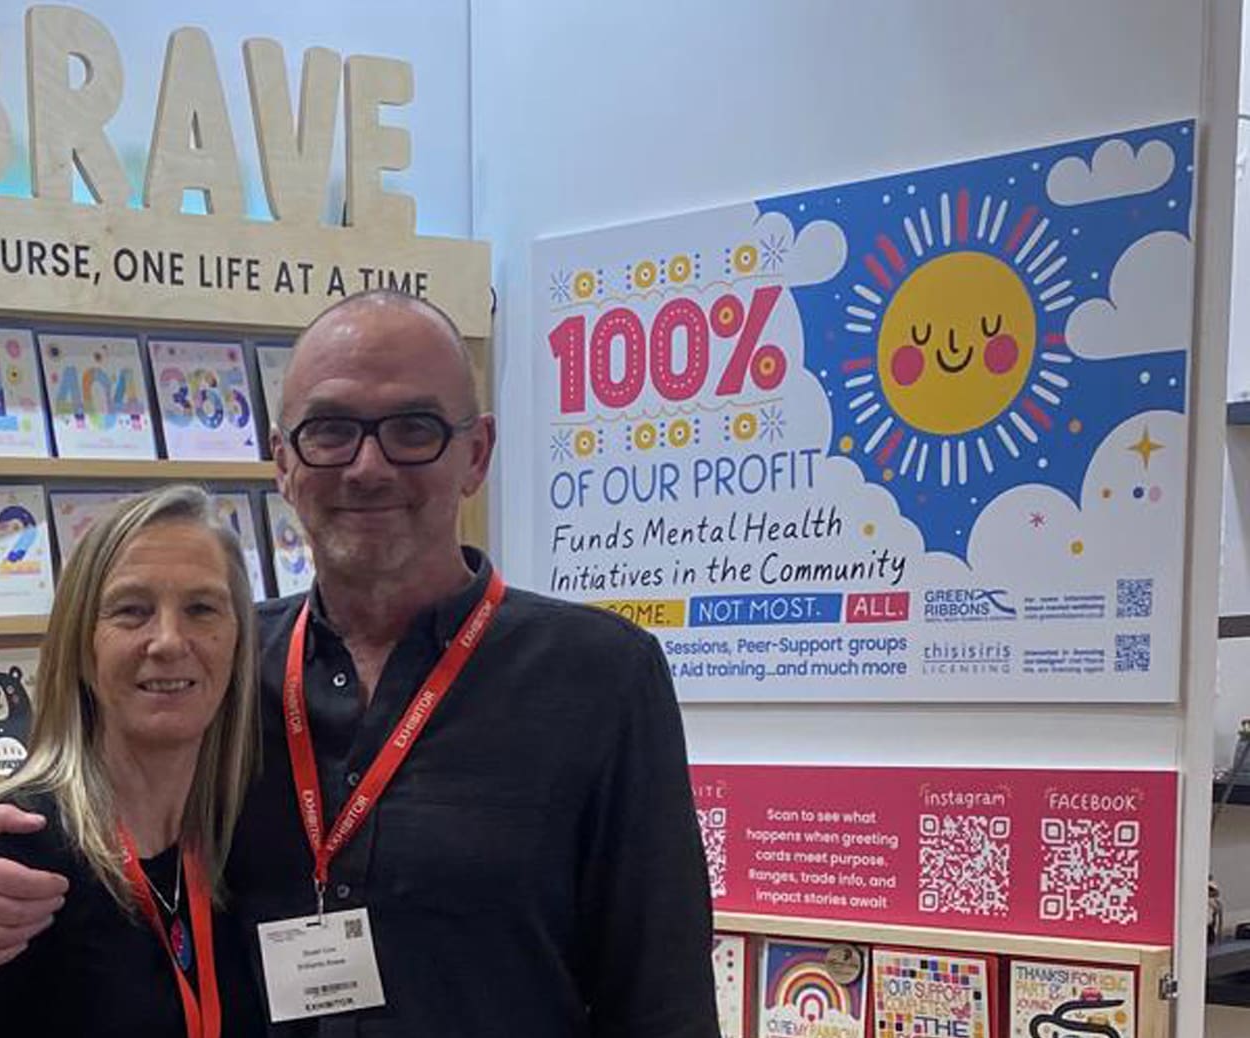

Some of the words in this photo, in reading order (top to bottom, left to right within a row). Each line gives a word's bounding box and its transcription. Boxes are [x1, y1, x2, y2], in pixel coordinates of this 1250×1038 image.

[113, 248, 185, 287] ONE
[199, 255, 260, 291] LIFE
[274, 261, 315, 294] AT
[327, 266, 346, 297] A
[358, 268, 428, 302] TIME
[548, 285, 787, 414] 100%
[158, 368, 250, 428] 365
[550, 470, 593, 510] OF
[603, 463, 680, 505] OUR
[694, 449, 821, 498] PROFIT
[552, 521, 634, 553] Funds
[643, 511, 735, 546] Mental
[744, 505, 842, 541] Health
[551, 563, 663, 592] Initiatives
[672, 560, 696, 585] in
[706, 555, 751, 584] the
[759, 550, 906, 586] Community
[925, 589, 978, 601] GREEN
[699, 602, 744, 622] NOT
[751, 599, 821, 620] MOST.
[853, 596, 905, 617] ALL.
[924, 602, 990, 616] RIBBONS
[665, 640, 731, 656] Sessions,
[737, 638, 845, 657] Peer-Support
[849, 637, 907, 656] groups
[680, 661, 703, 677] Aid
[810, 660, 858, 676] much
[861, 663, 907, 675] more
[1049, 792, 1136, 812] FACEBOOK
[766, 808, 799, 821] Scan
[801, 810, 814, 821] to
[817, 812, 839, 822] see
[843, 811, 876, 823] what
[746, 828, 801, 844] happens
[804, 831, 839, 843] when
[841, 832, 899, 849] greeting
[755, 850, 791, 861] cards
[793, 851, 828, 863] meet
[801, 871, 836, 884] trade
[869, 876, 896, 888] and
[804, 891, 847, 905] stories
[915, 1016, 969, 1038] THE
